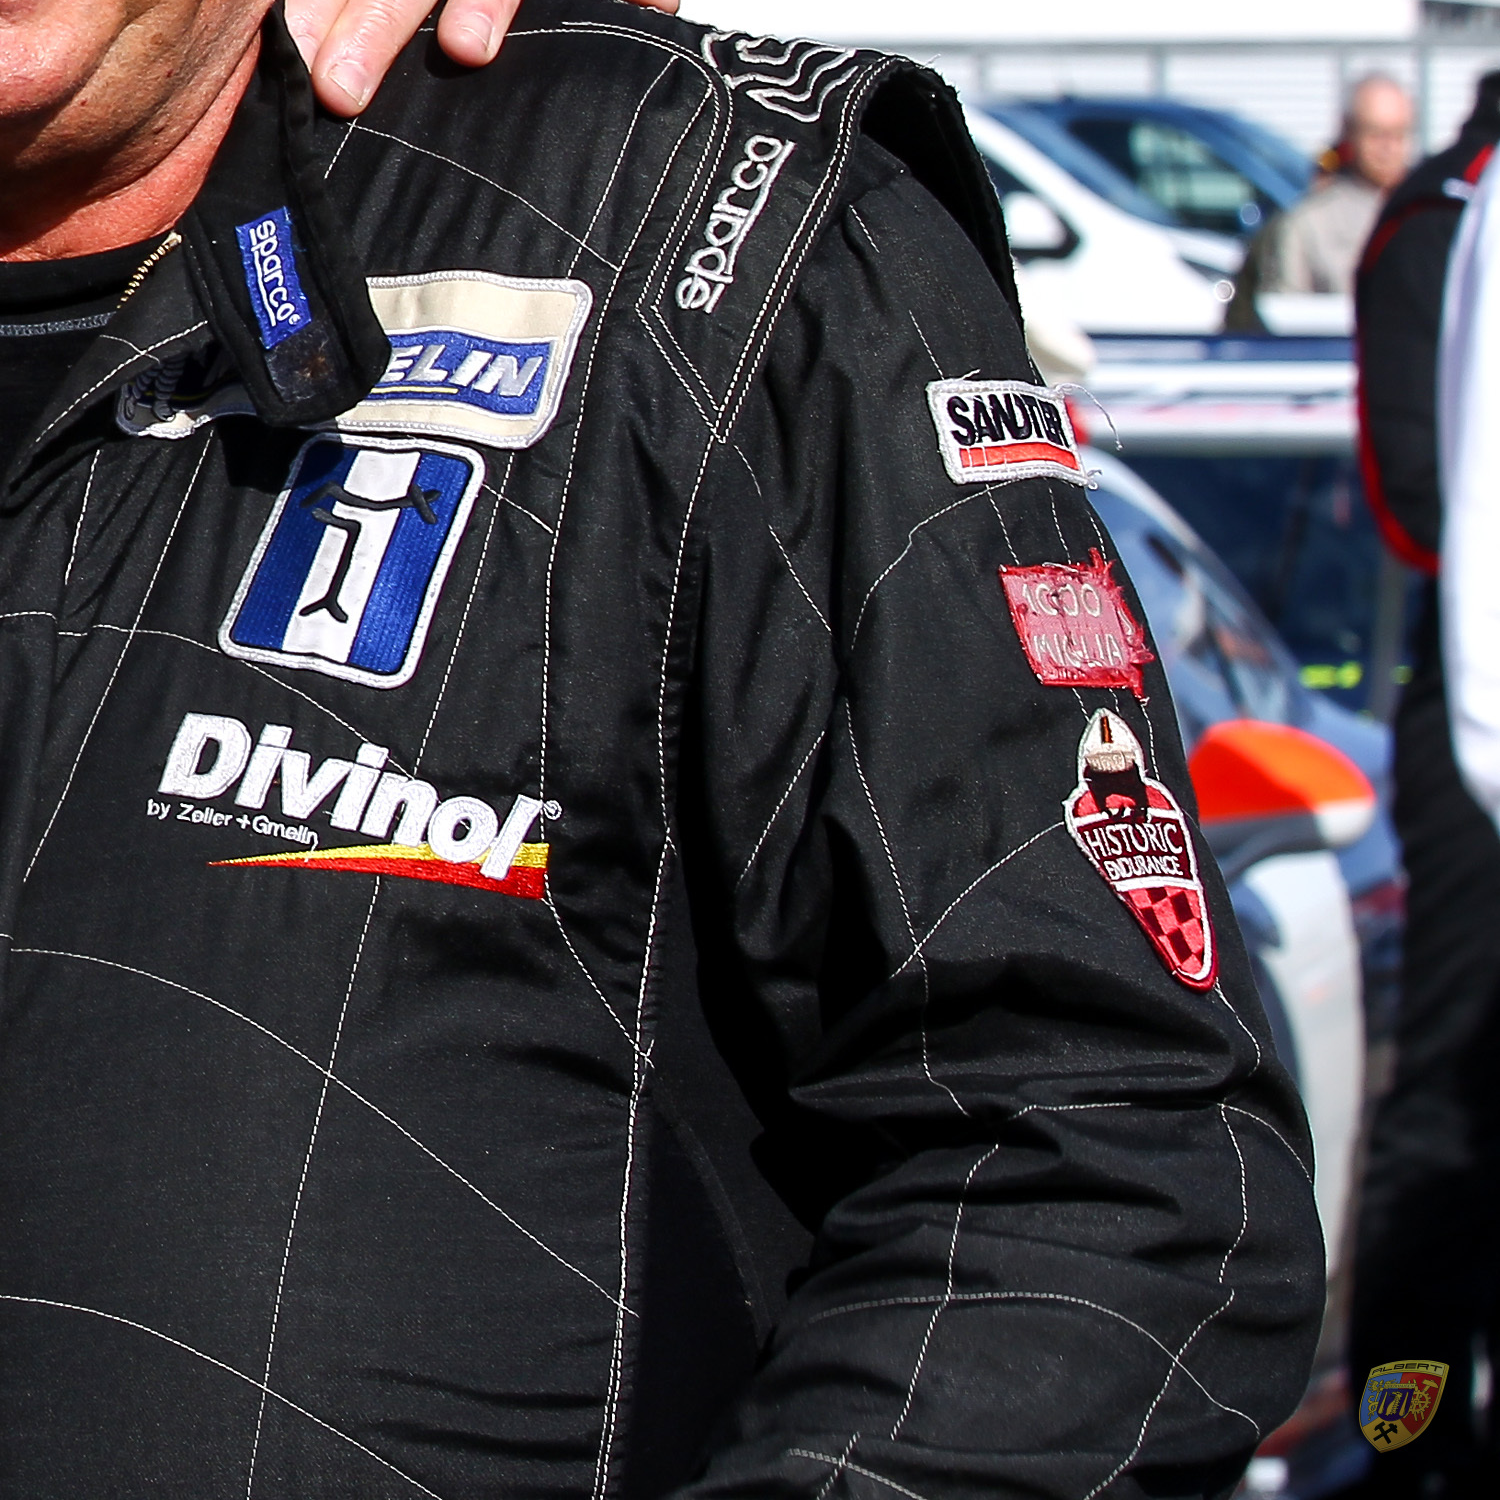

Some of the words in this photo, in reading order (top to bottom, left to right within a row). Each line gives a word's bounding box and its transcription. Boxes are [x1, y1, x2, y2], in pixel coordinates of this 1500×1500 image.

[250, 219, 297, 326] sparco
[378, 343, 544, 397] ELIN
[146, 798, 171, 820] by
[157, 711, 543, 881] Divinol
[1083, 821, 1184, 862] HISTORIC
[1371, 1362, 1443, 1376] ALBERT
